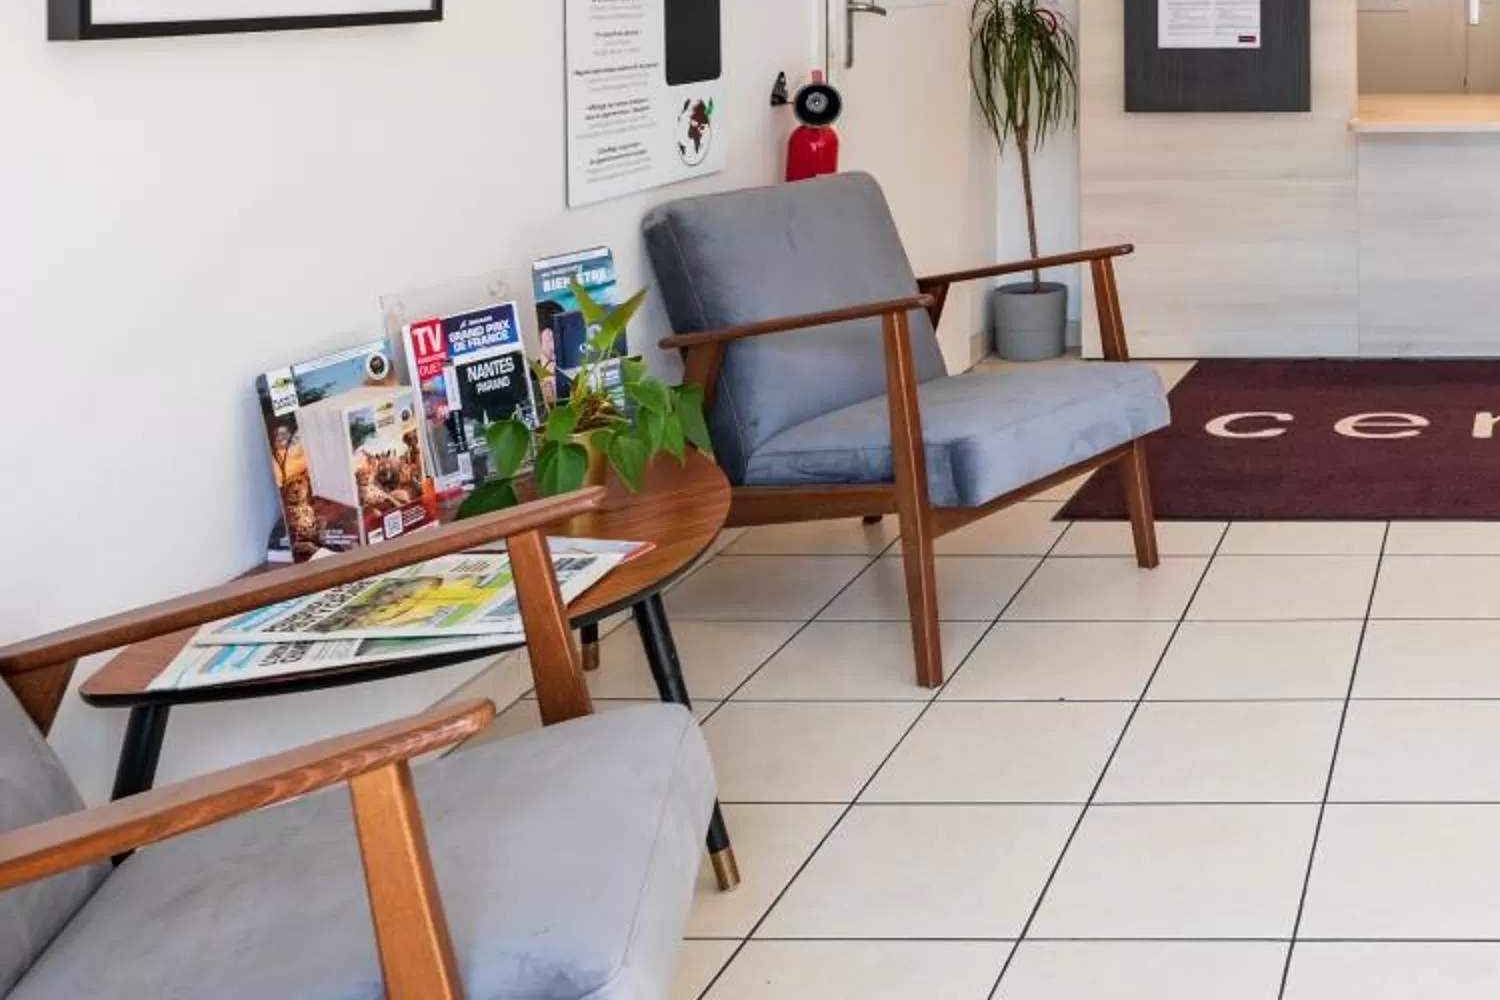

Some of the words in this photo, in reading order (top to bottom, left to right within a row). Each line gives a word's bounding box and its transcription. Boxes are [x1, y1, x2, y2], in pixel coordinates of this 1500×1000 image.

[412, 322, 442, 356] TV
[448, 326, 485, 343] GRAND
[486, 319, 510, 333] PRIX
[453, 342, 466, 352] DE
[468, 329, 509, 349] FRANCE
[466, 356, 515, 382] NANTES
